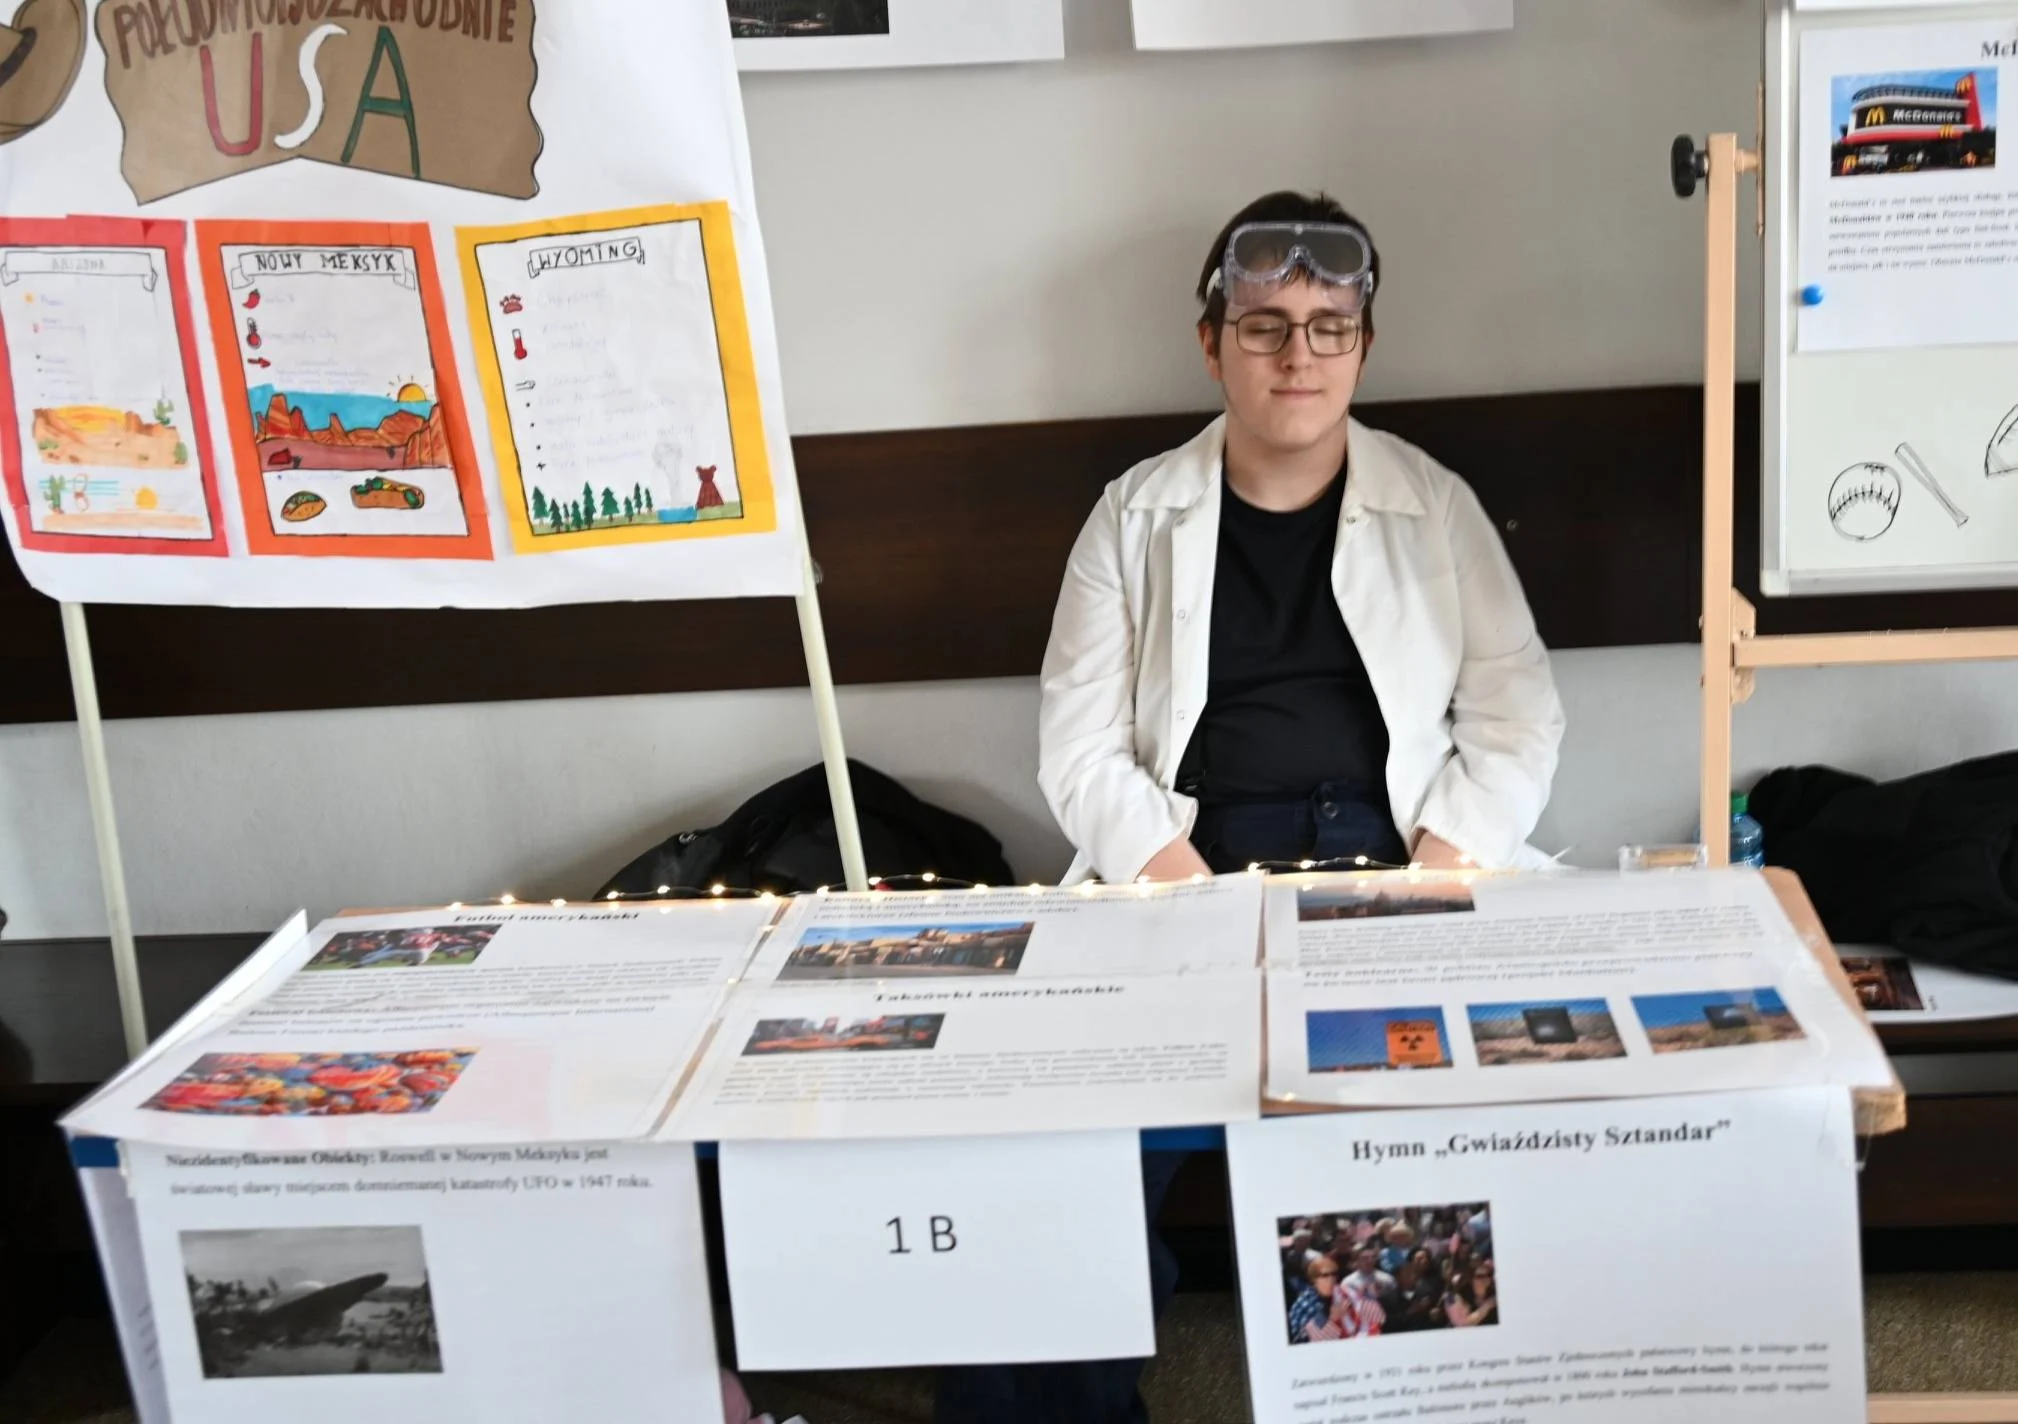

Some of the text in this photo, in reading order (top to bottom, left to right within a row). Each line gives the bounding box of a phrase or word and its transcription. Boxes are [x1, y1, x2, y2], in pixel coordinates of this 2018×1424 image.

[203, 24, 422, 180] USA
[255, 253, 397, 272] NOWY MEKSYK
[538, 241, 637, 270] WYOMING
[379, 1148, 436, 1162] Roswell
[441, 1151, 451, 1161] w
[456, 1148, 511, 1163] Nowym
[515, 1147, 581, 1163] Meksyku
[584, 1147, 609, 1162] jest
[1352, 1139, 1427, 1164] Hymn
[450, 1176, 519, 1194] katastrofy
[522, 1176, 559, 1190] UFO
[562, 1179, 574, 1189] w
[579, 1174, 613, 1189] 1947
[886, 1214, 957, 1254] 1 B
